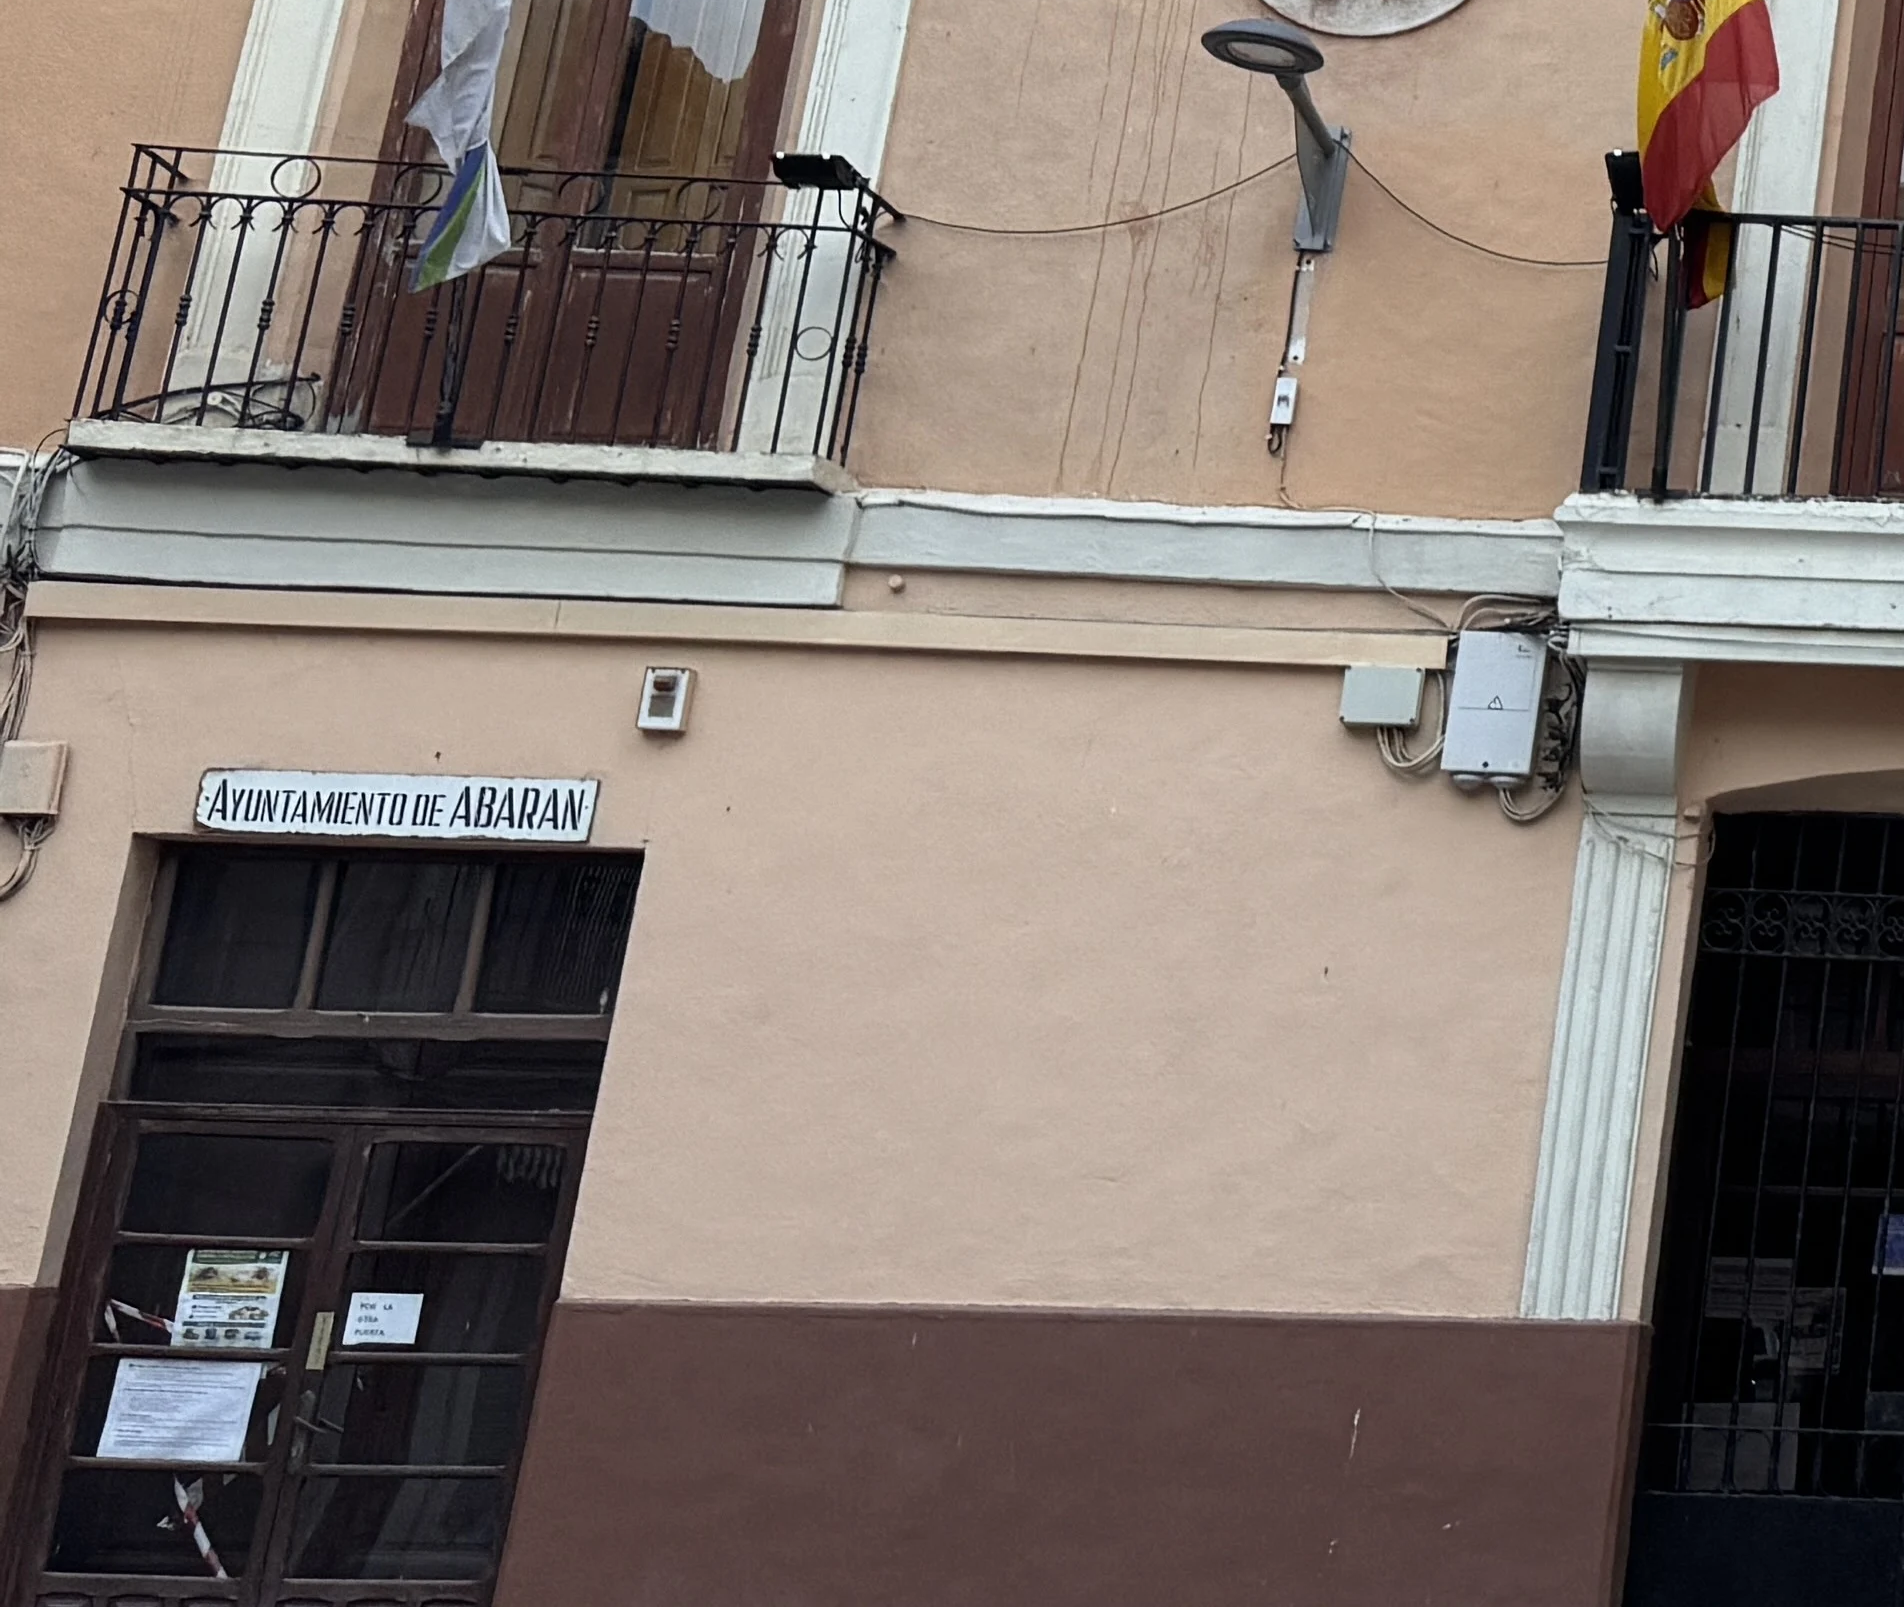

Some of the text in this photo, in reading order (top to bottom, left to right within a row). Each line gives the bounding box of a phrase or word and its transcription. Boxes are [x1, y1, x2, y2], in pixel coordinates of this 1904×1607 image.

[207, 778, 587, 832] AYUNTAMIENTO DE ABARAN
[383, 1303, 393, 1311] LA
